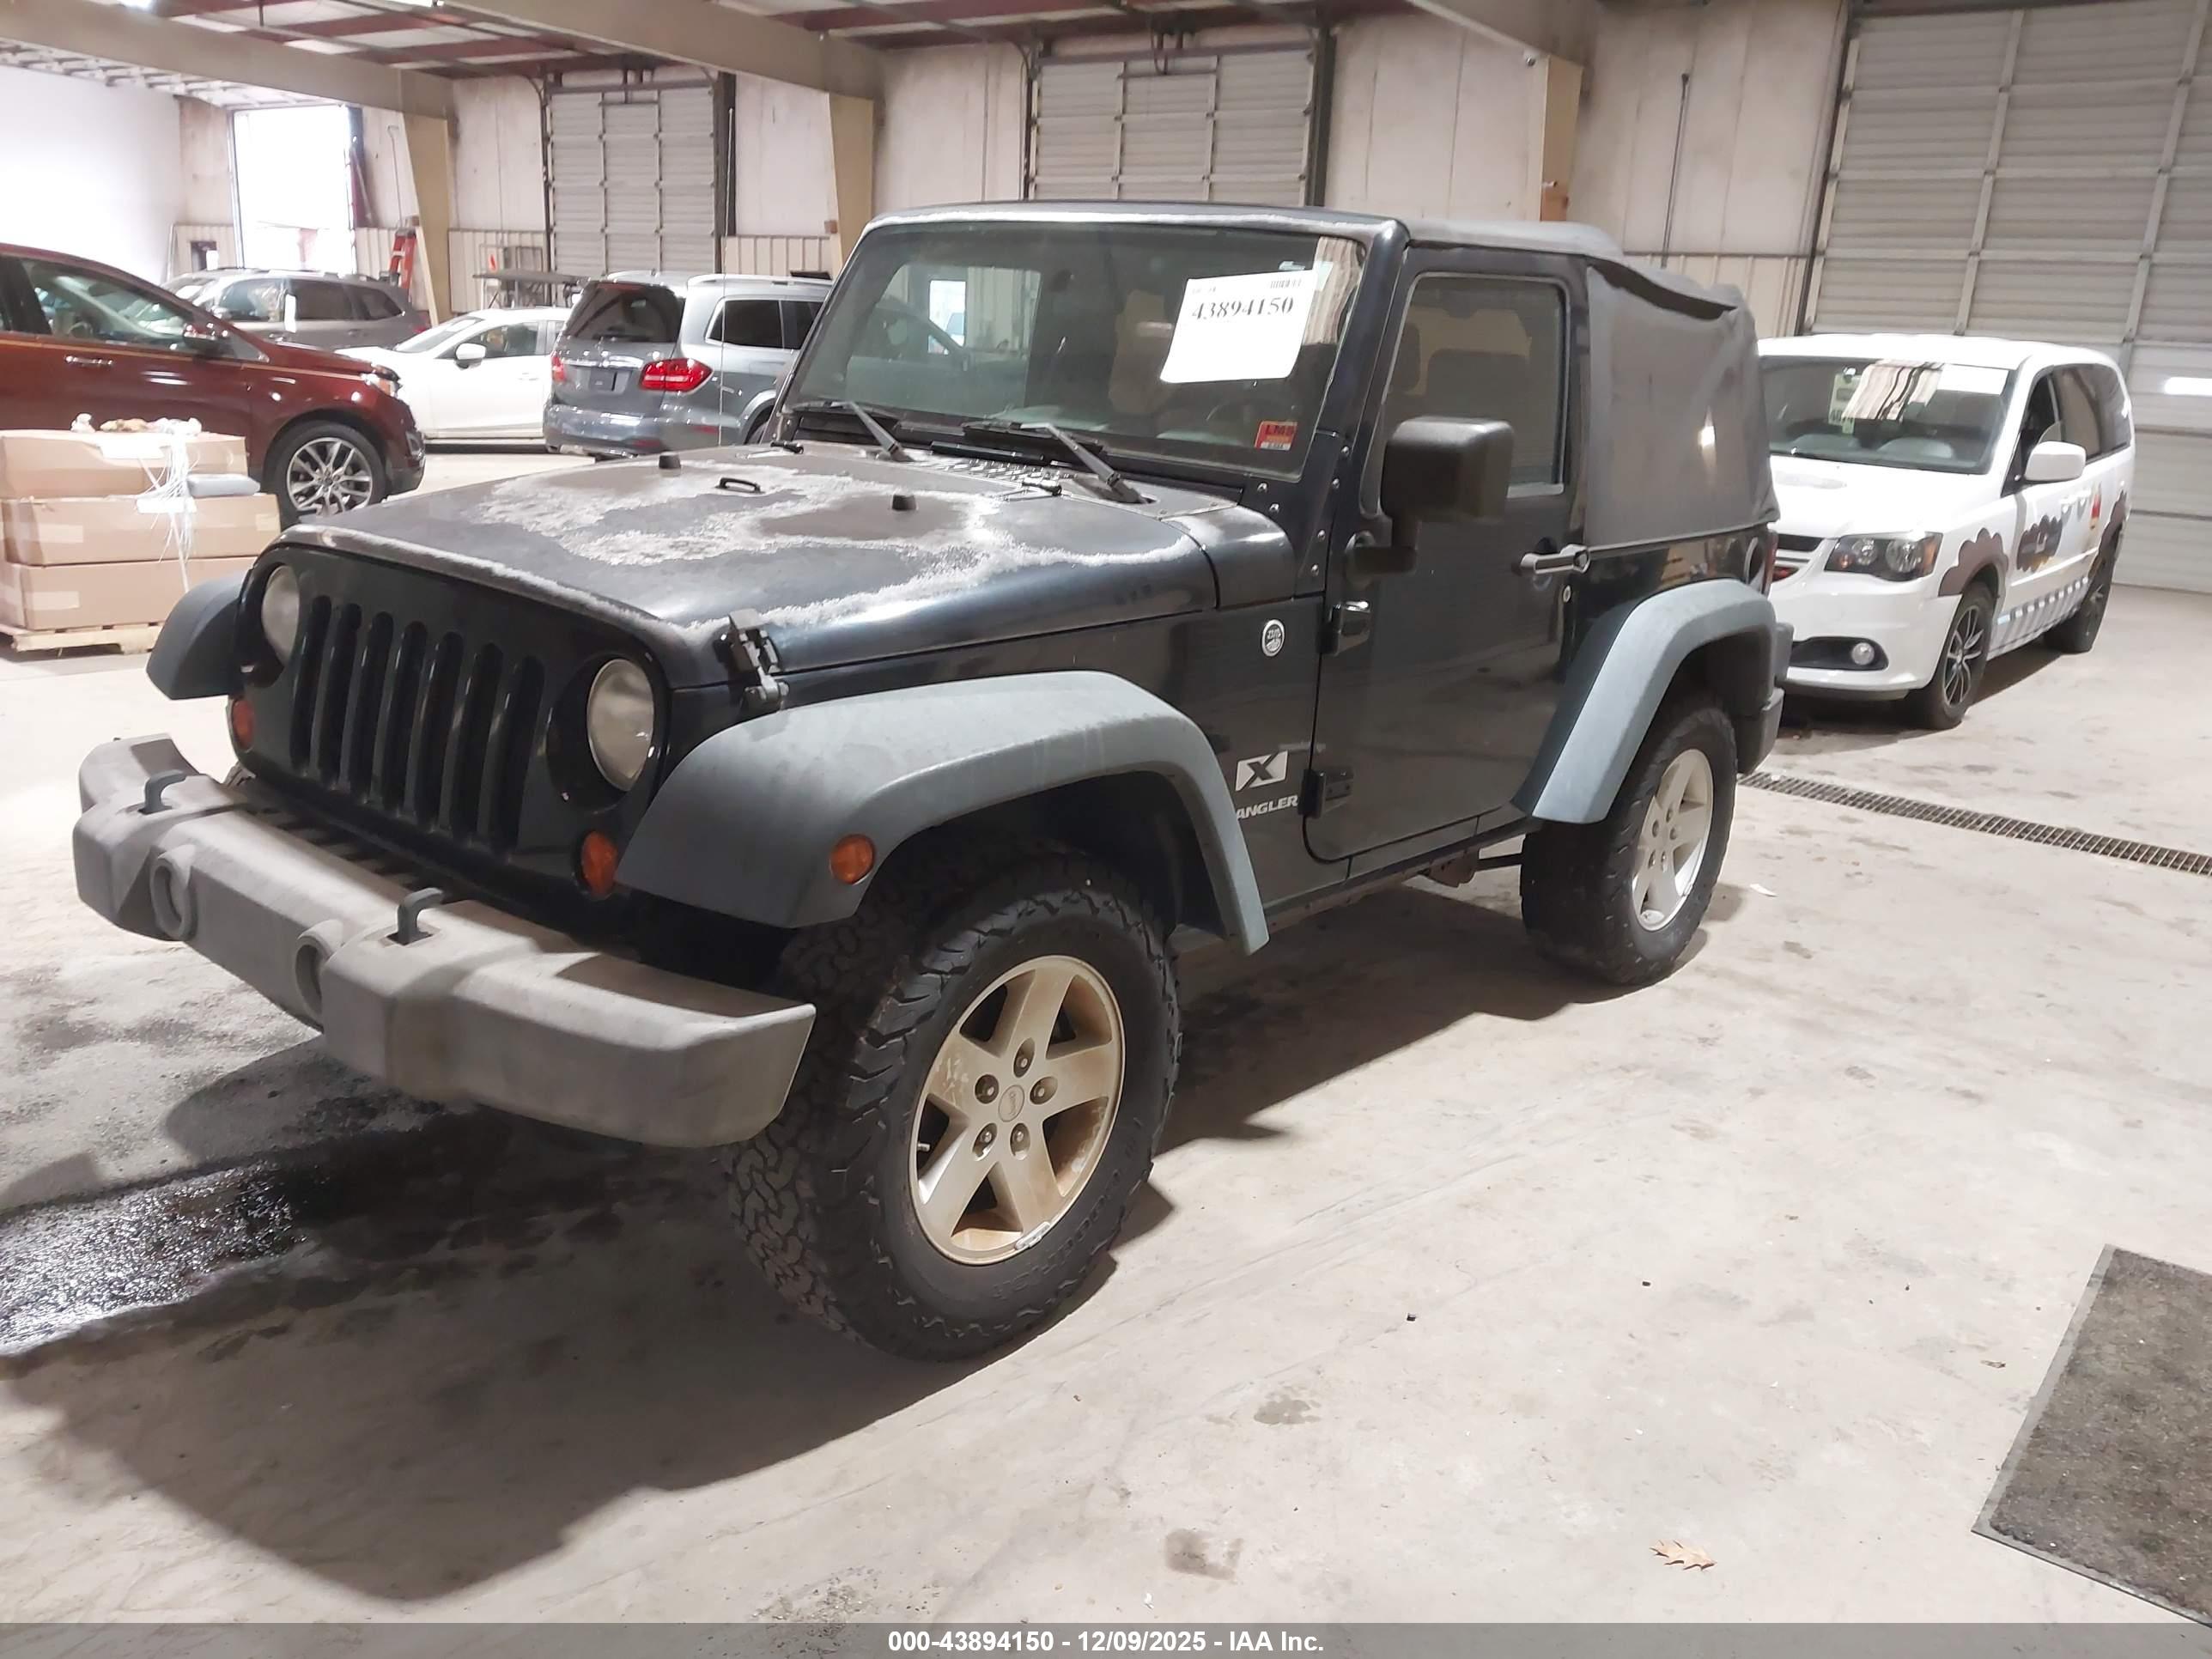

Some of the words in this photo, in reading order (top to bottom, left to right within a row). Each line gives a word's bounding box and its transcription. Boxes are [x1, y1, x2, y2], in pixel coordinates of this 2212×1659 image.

[1191, 296, 1294, 320] 43894150
[1238, 751, 1284, 791] X
[1237, 794, 1298, 820] ANGLER
